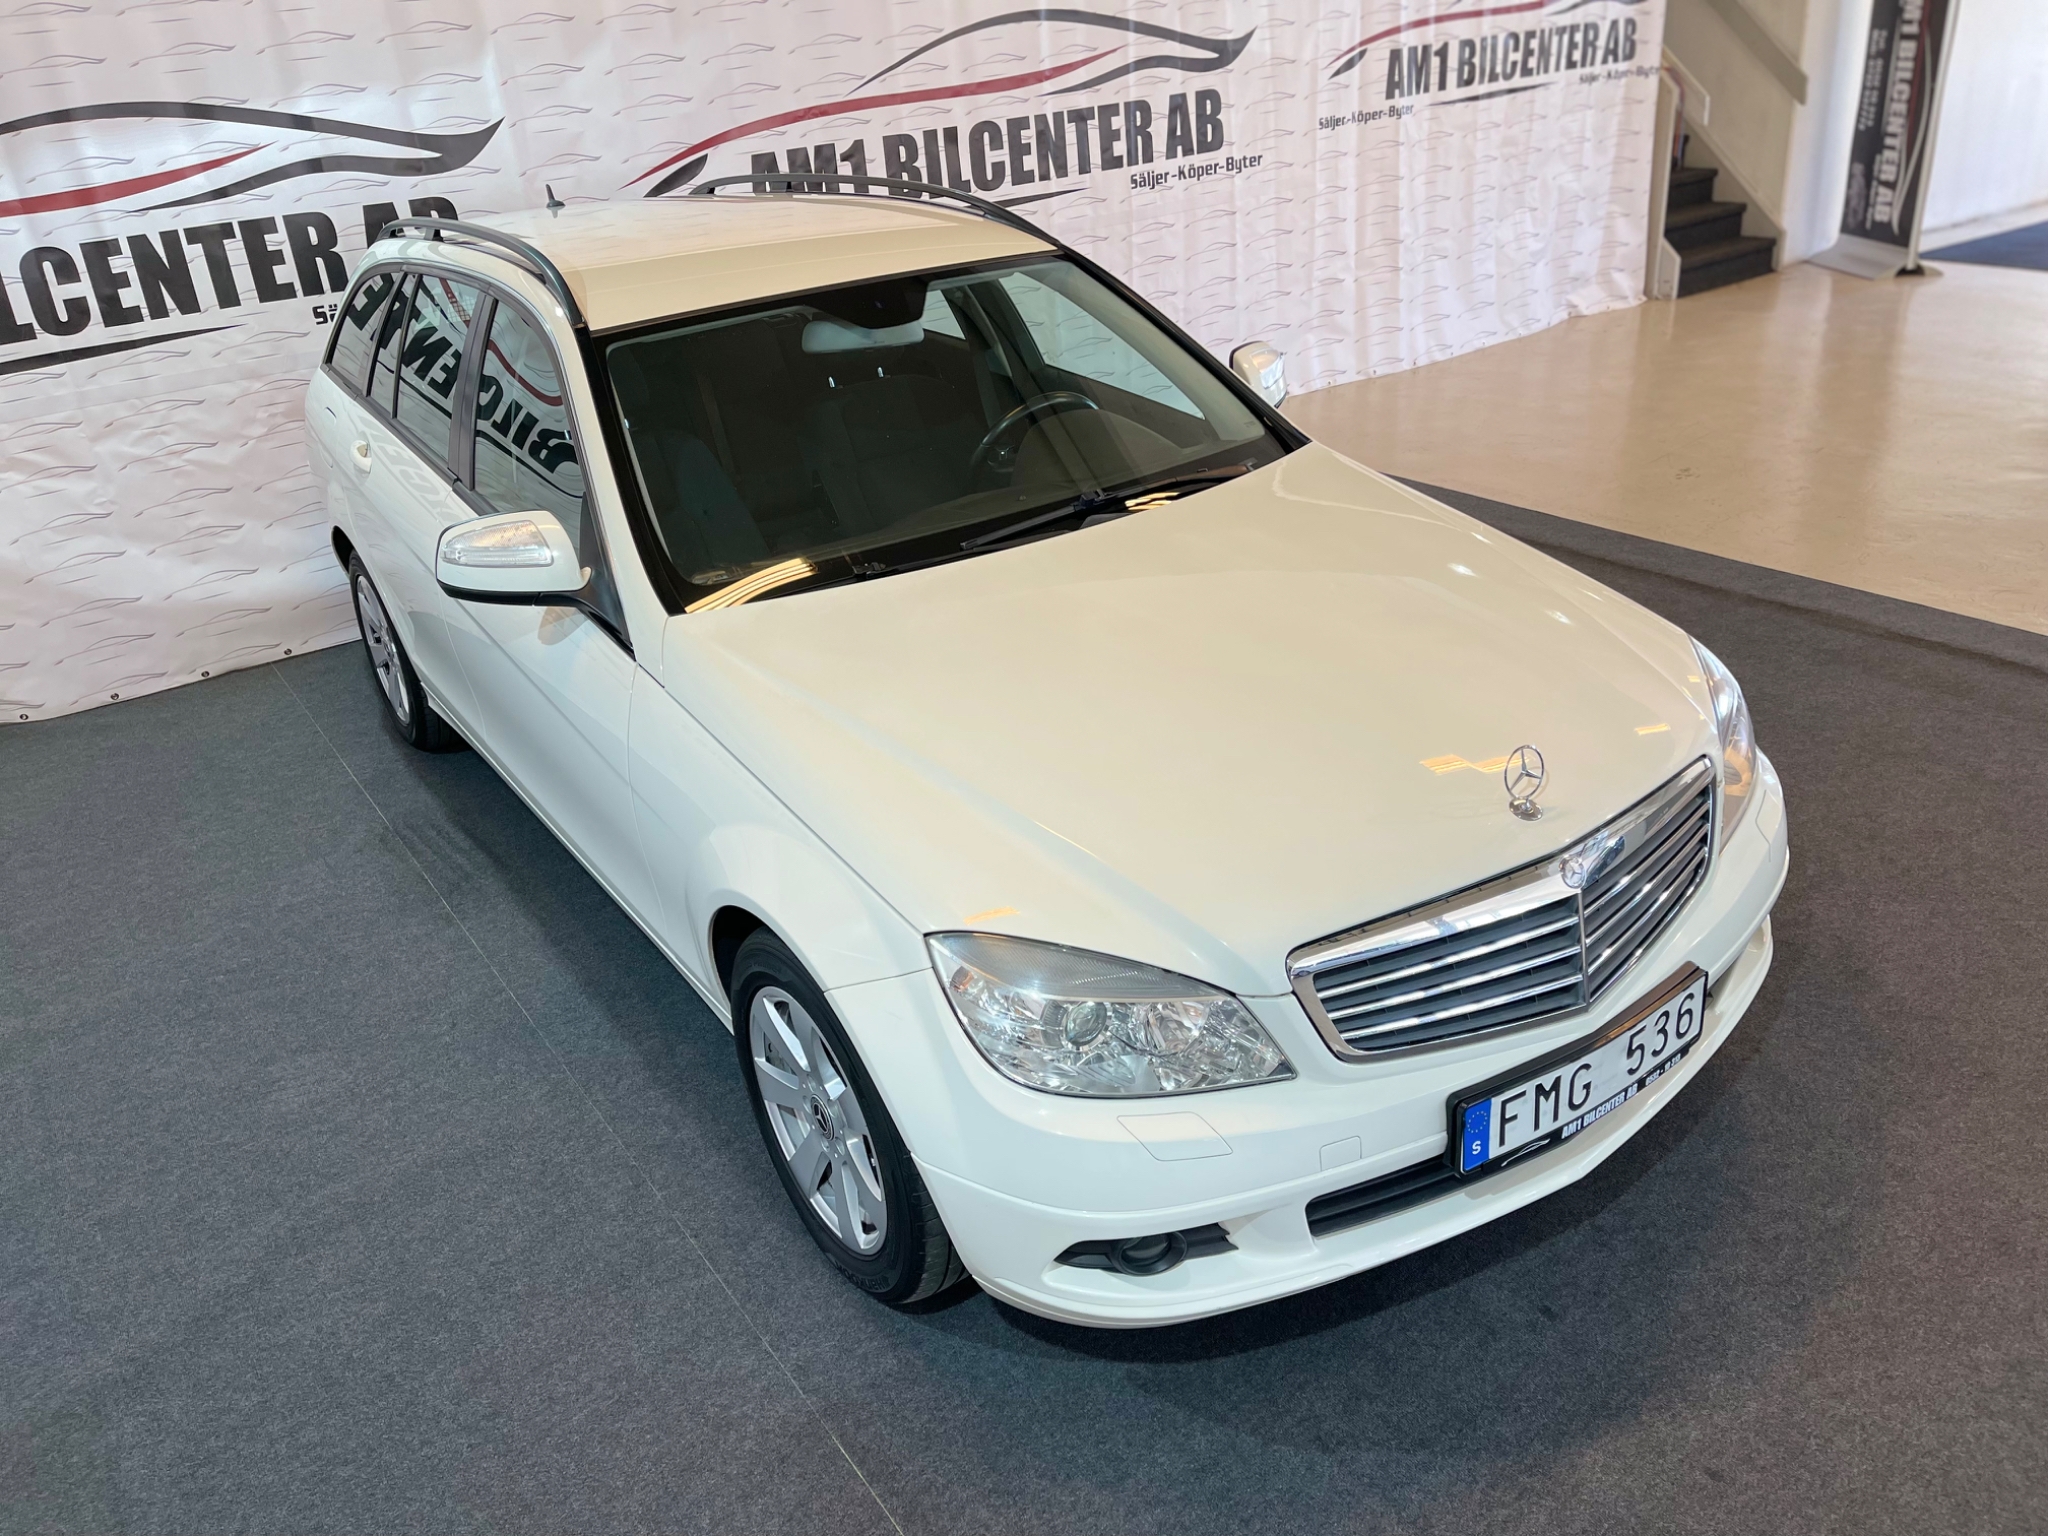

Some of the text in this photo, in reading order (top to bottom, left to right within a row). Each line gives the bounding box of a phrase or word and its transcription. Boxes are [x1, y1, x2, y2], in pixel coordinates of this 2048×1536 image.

[1385, 17, 1637, 100] AM1 BILCENTER AB
[751, 88, 1225, 201] AM1 BILCENTER AB
[1880, 39, 1918, 183] BILCENTER
[1874, 183, 1895, 223] AB
[1498, 992, 1696, 1148] FMG 536
[1561, 1118, 1582, 1140] AM1
[1582, 1091, 1626, 1127] BILCENTER
[1625, 1082, 1638, 1100] AB
[1471, 1140, 1482, 1155] S
